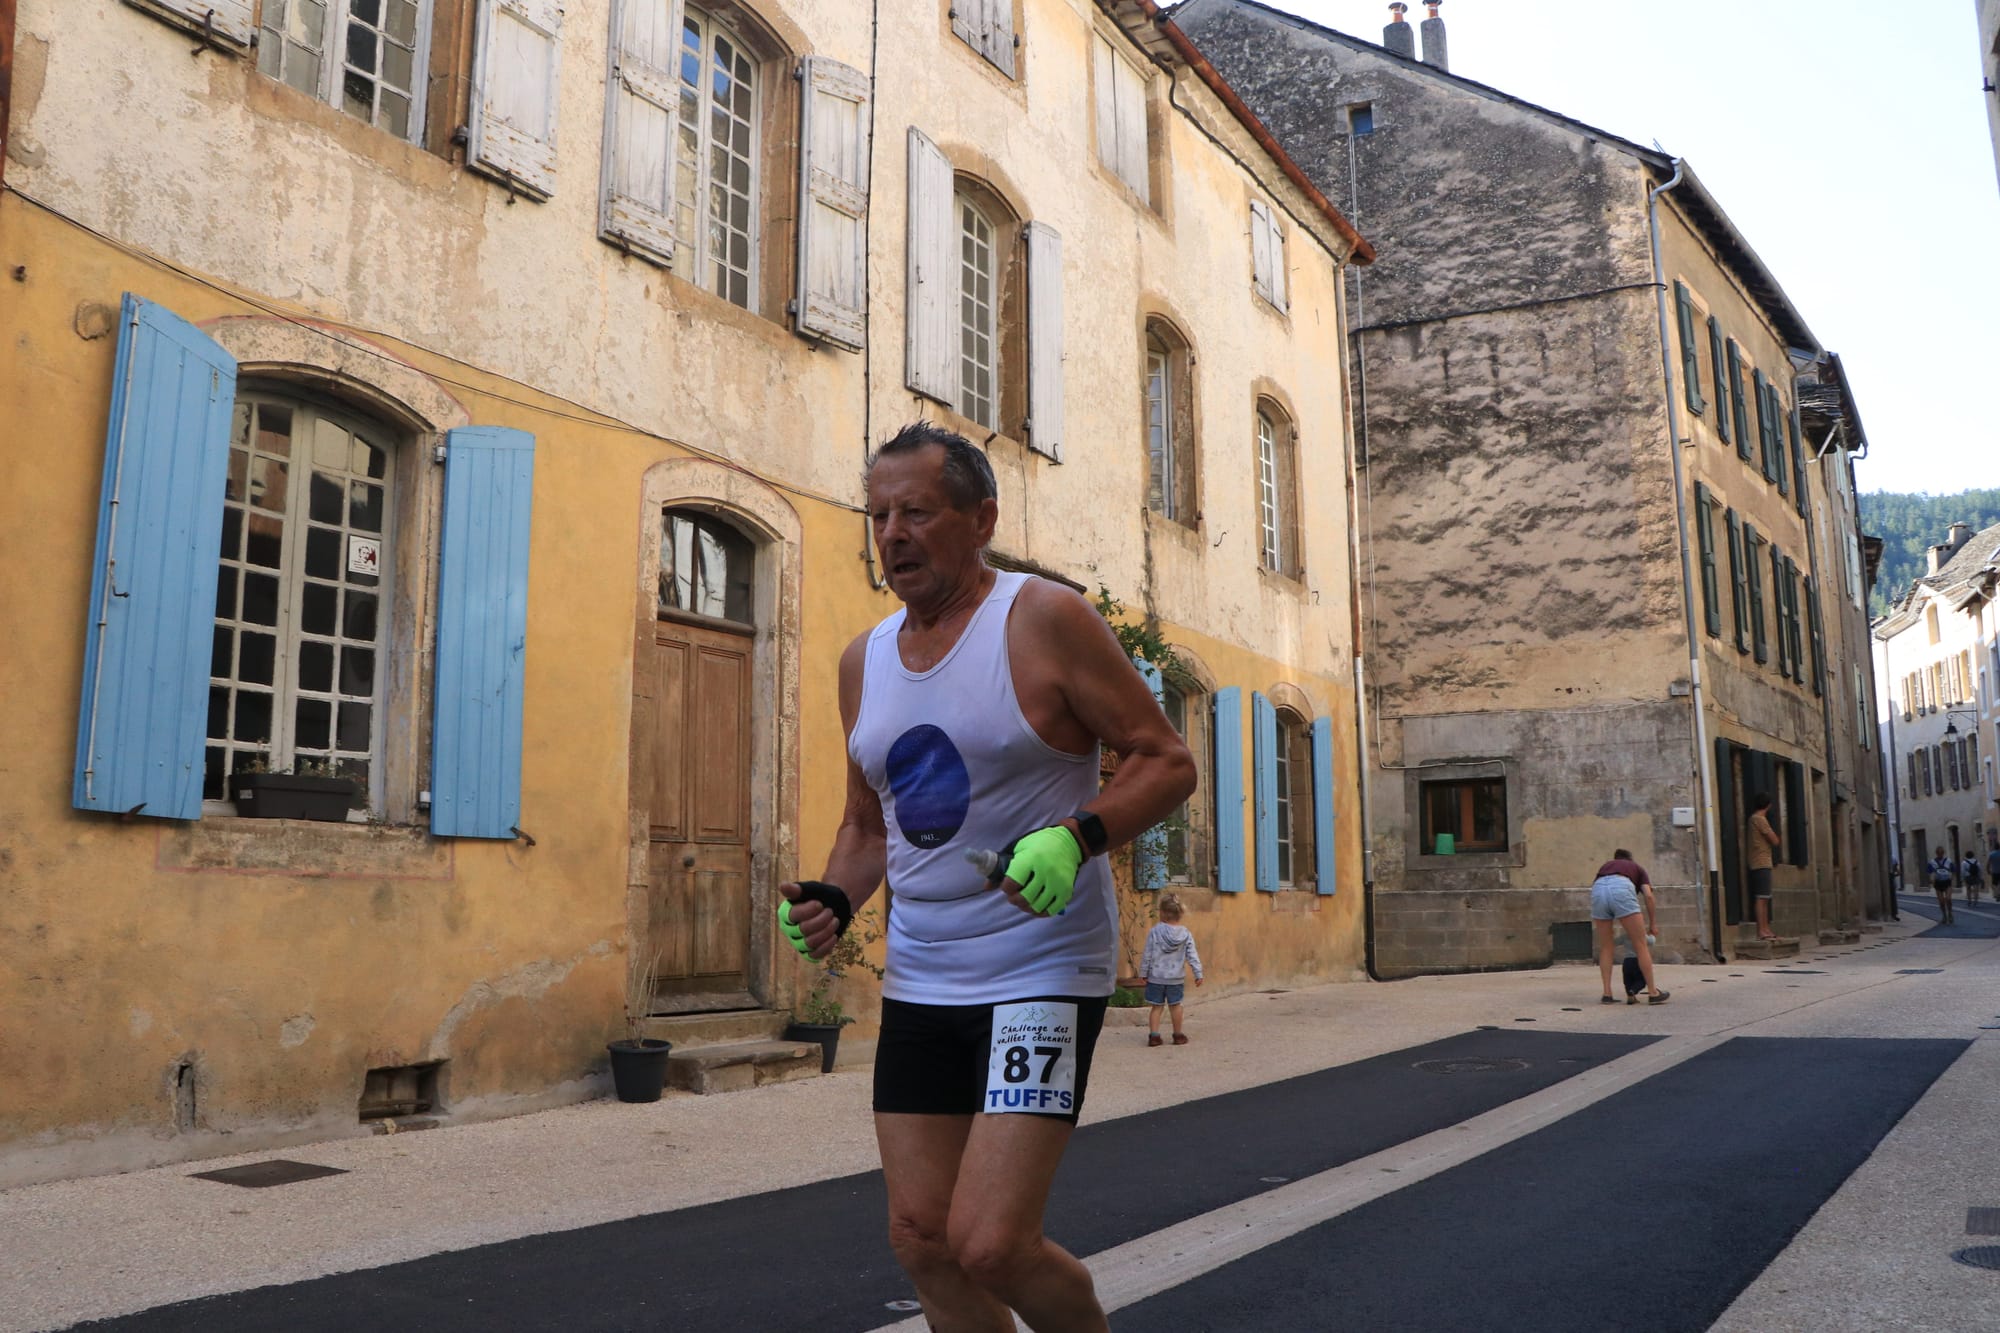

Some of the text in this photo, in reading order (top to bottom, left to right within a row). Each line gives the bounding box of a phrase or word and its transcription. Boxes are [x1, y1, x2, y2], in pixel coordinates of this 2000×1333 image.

[1001, 1024, 1069, 1035] Challenge des
[997, 1034, 1072, 1045] vallées cévenoles
[1003, 1046, 1062, 1084] 87
[988, 1089, 1073, 1109] TUFF'S
